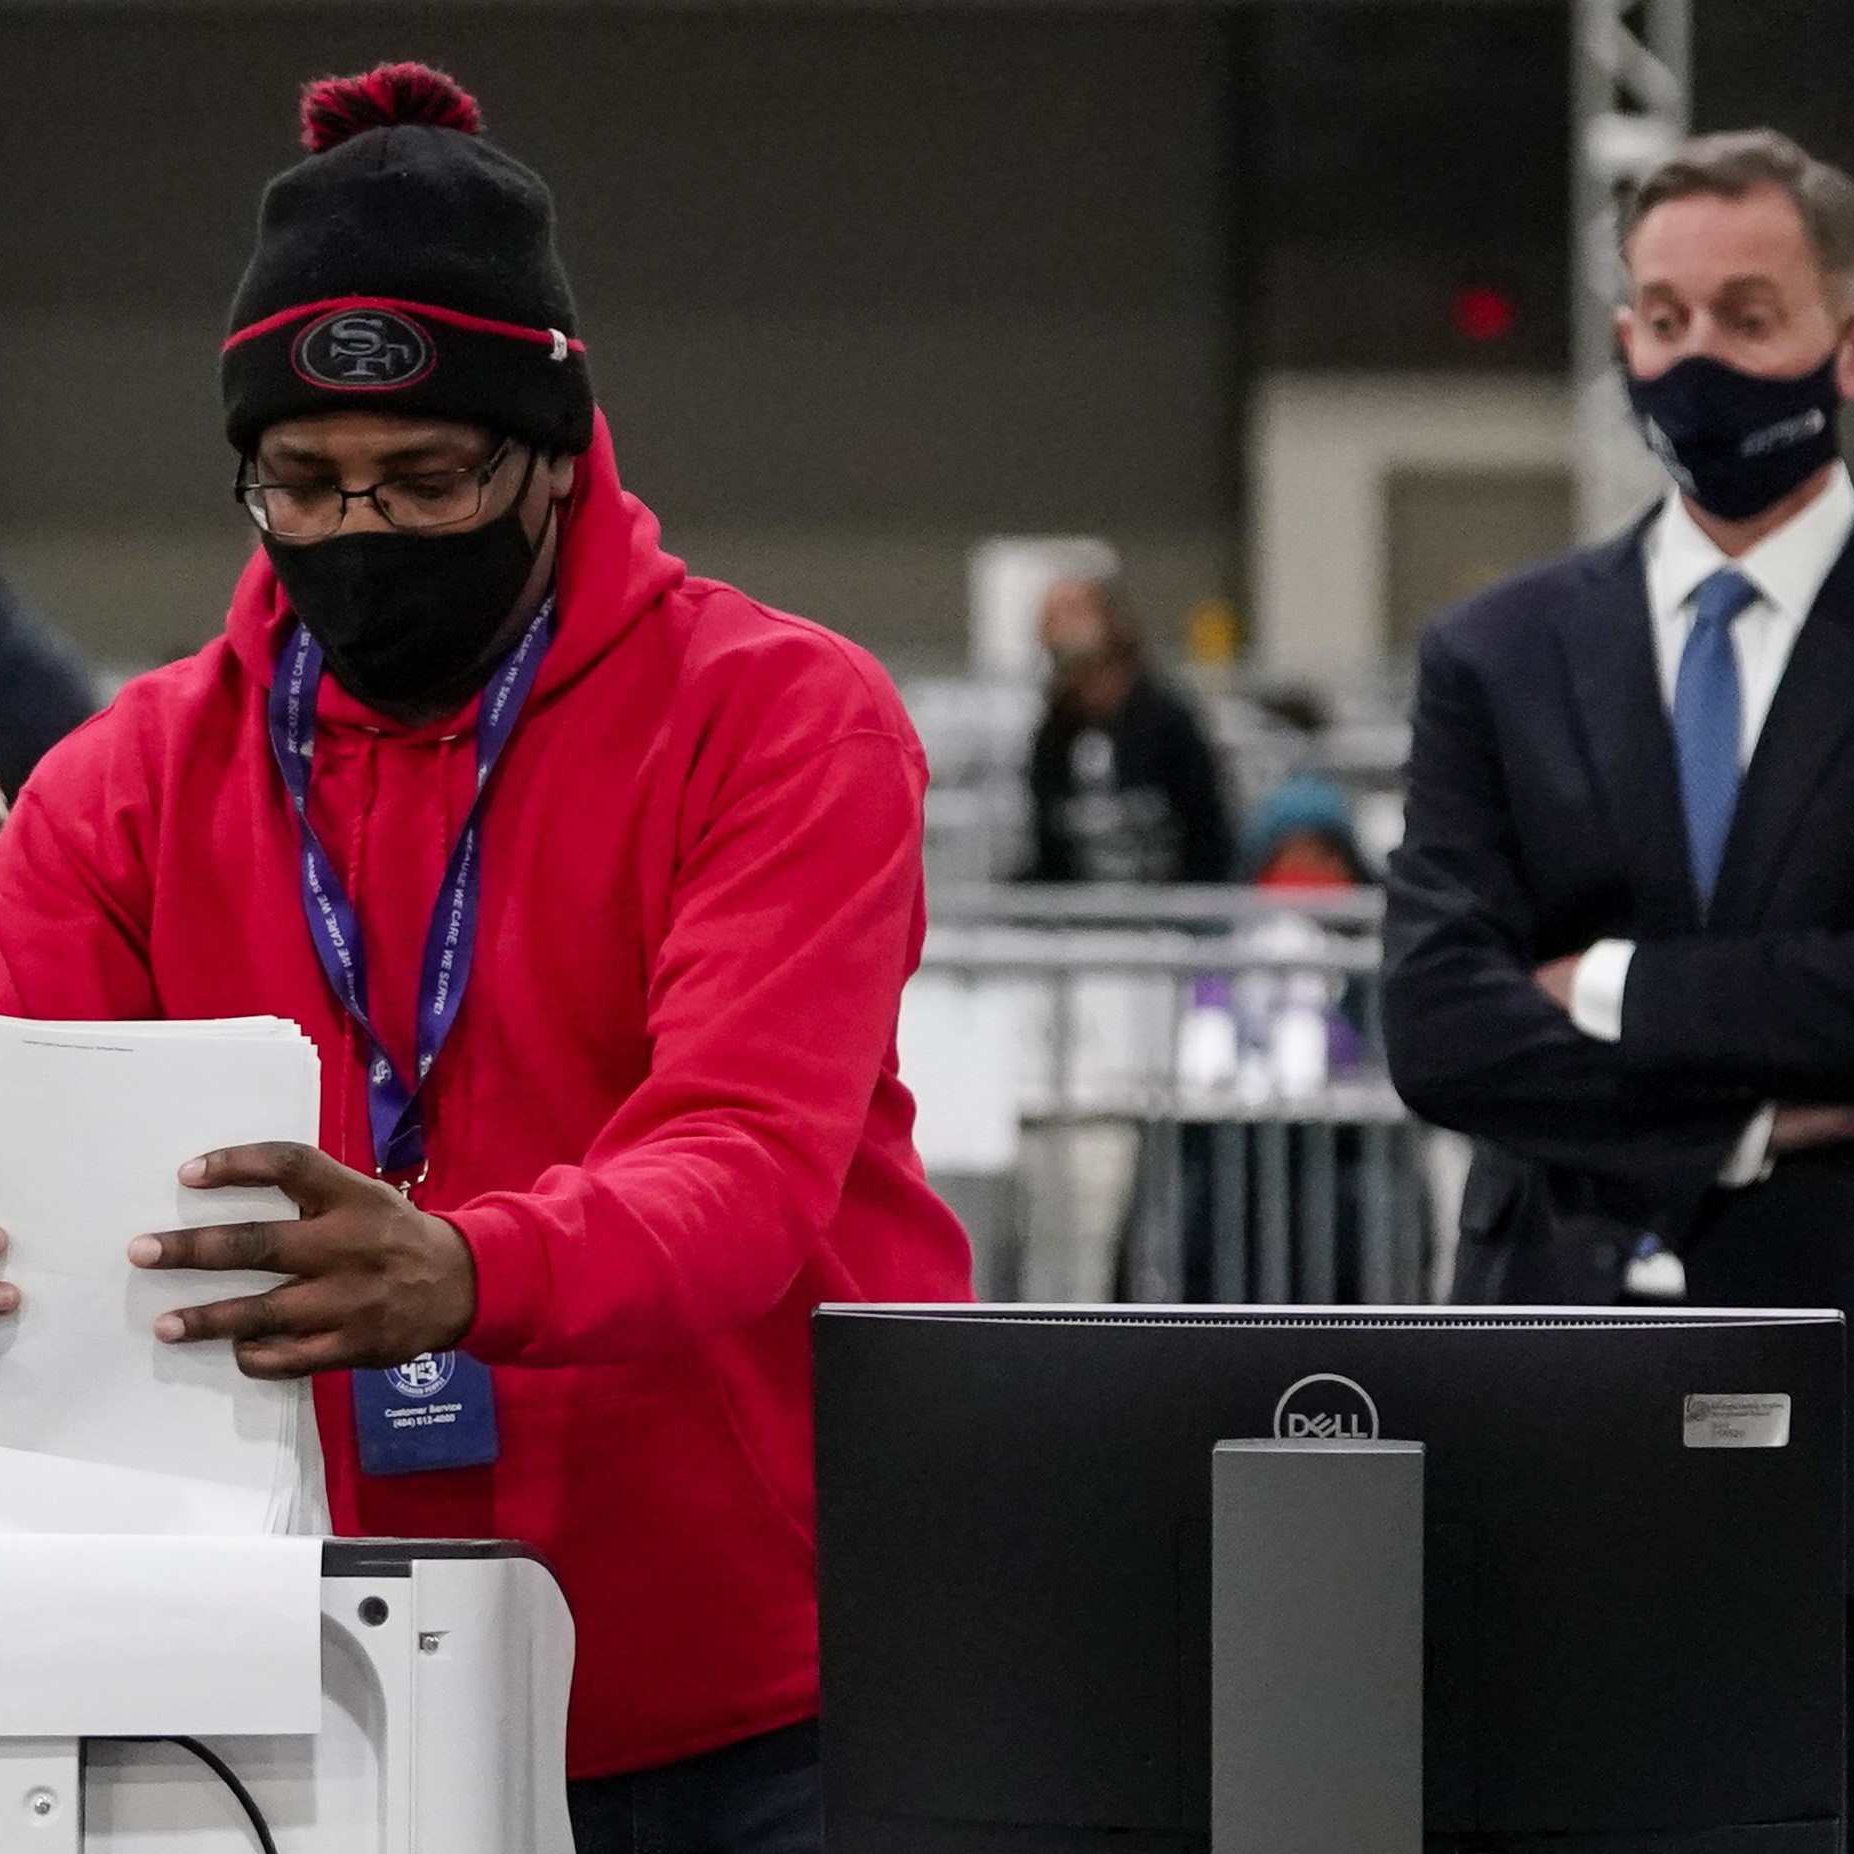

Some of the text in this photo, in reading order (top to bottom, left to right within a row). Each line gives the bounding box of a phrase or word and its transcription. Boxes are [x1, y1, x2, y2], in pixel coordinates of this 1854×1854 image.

[317, 894, 333, 914] WE
[452, 888, 465, 909] WE
[337, 947, 353, 968] WE
[441, 949, 455, 970] WE
[385, 1403, 462, 1418] Customer Service
[1288, 1412, 1368, 1438] DELL
